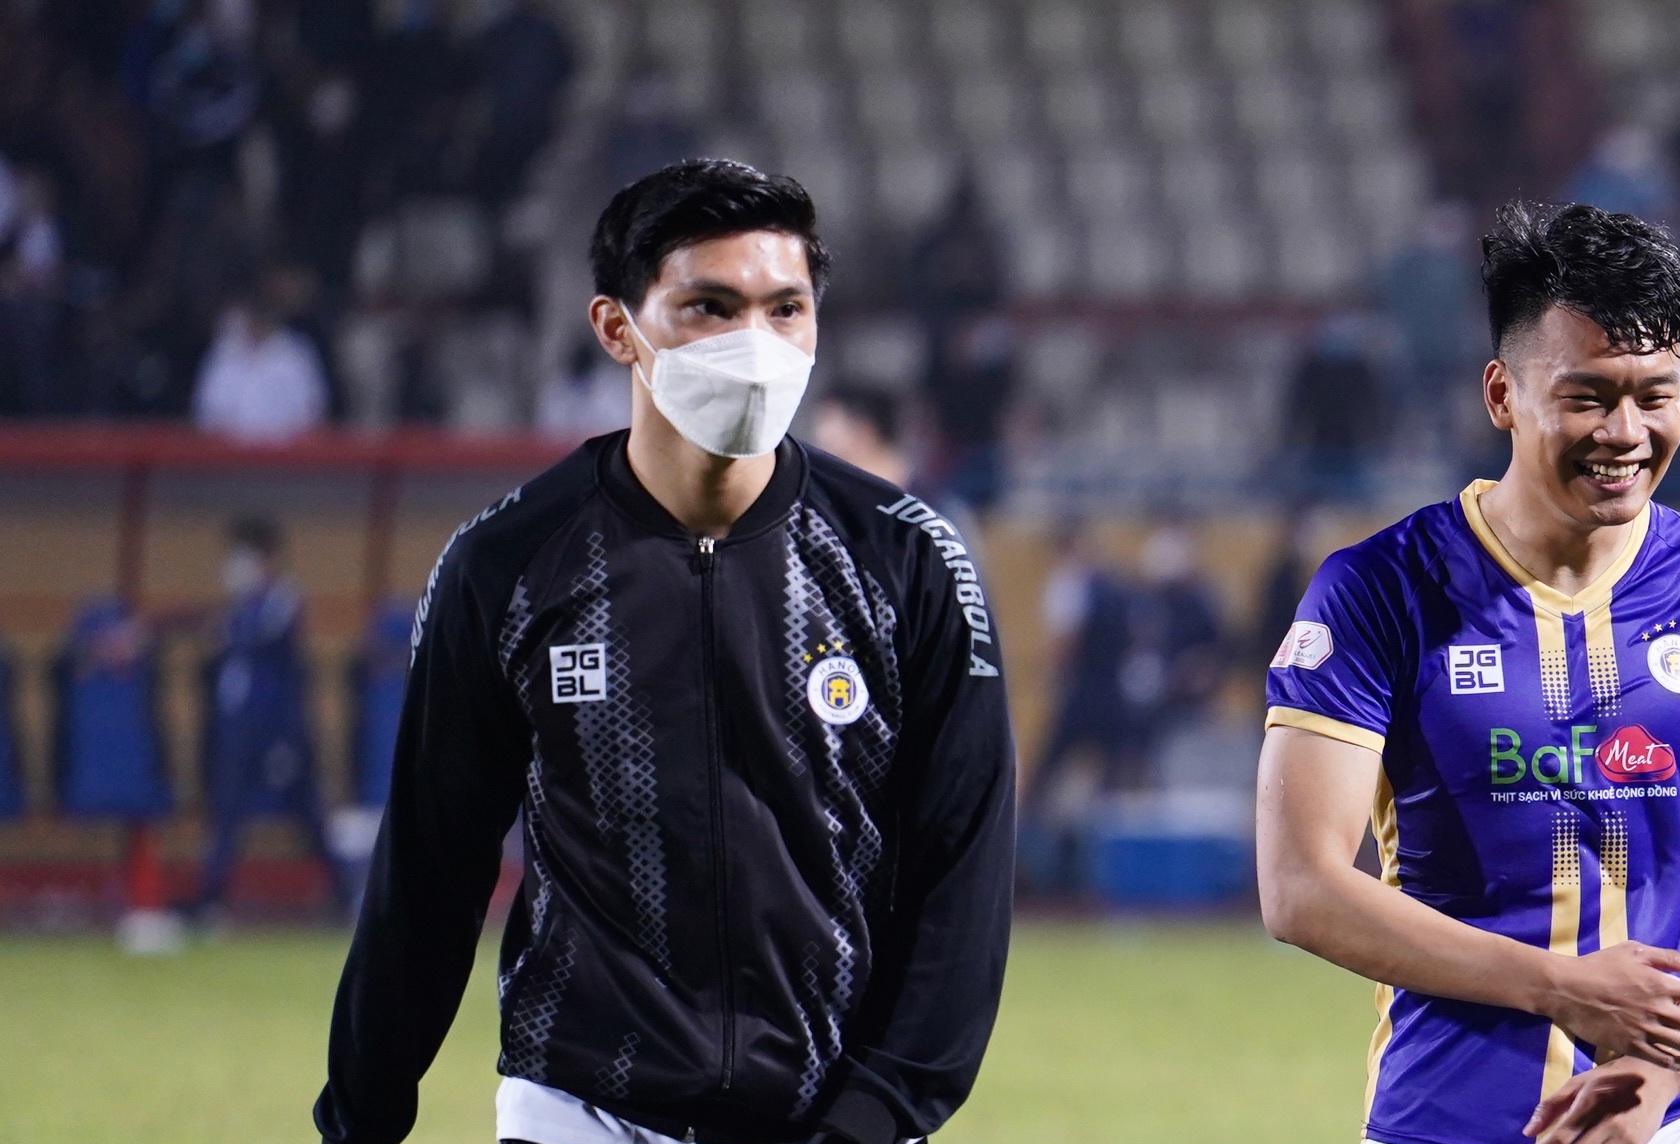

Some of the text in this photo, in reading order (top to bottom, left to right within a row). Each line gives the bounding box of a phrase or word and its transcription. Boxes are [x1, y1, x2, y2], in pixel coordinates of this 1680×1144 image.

[876, 493, 999, 677] JOGARBOLA
[557, 649, 599, 672] JG
[1455, 649, 1496, 668] JG
[557, 675, 600, 697] BL
[1455, 671, 1499, 689] BL
[1490, 725, 1597, 784] BaF
[1605, 739, 1670, 771] Meat
[1490, 791, 1516, 803] THỊT
[1518, 790, 1548, 803] SẠCH
[1550, 788, 1561, 801] VÌ
[1563, 789, 1586, 801] SỨC
[1616, 786, 1645, 801] CỘNG
[1647, 784, 1677, 798] ĐỒNG
